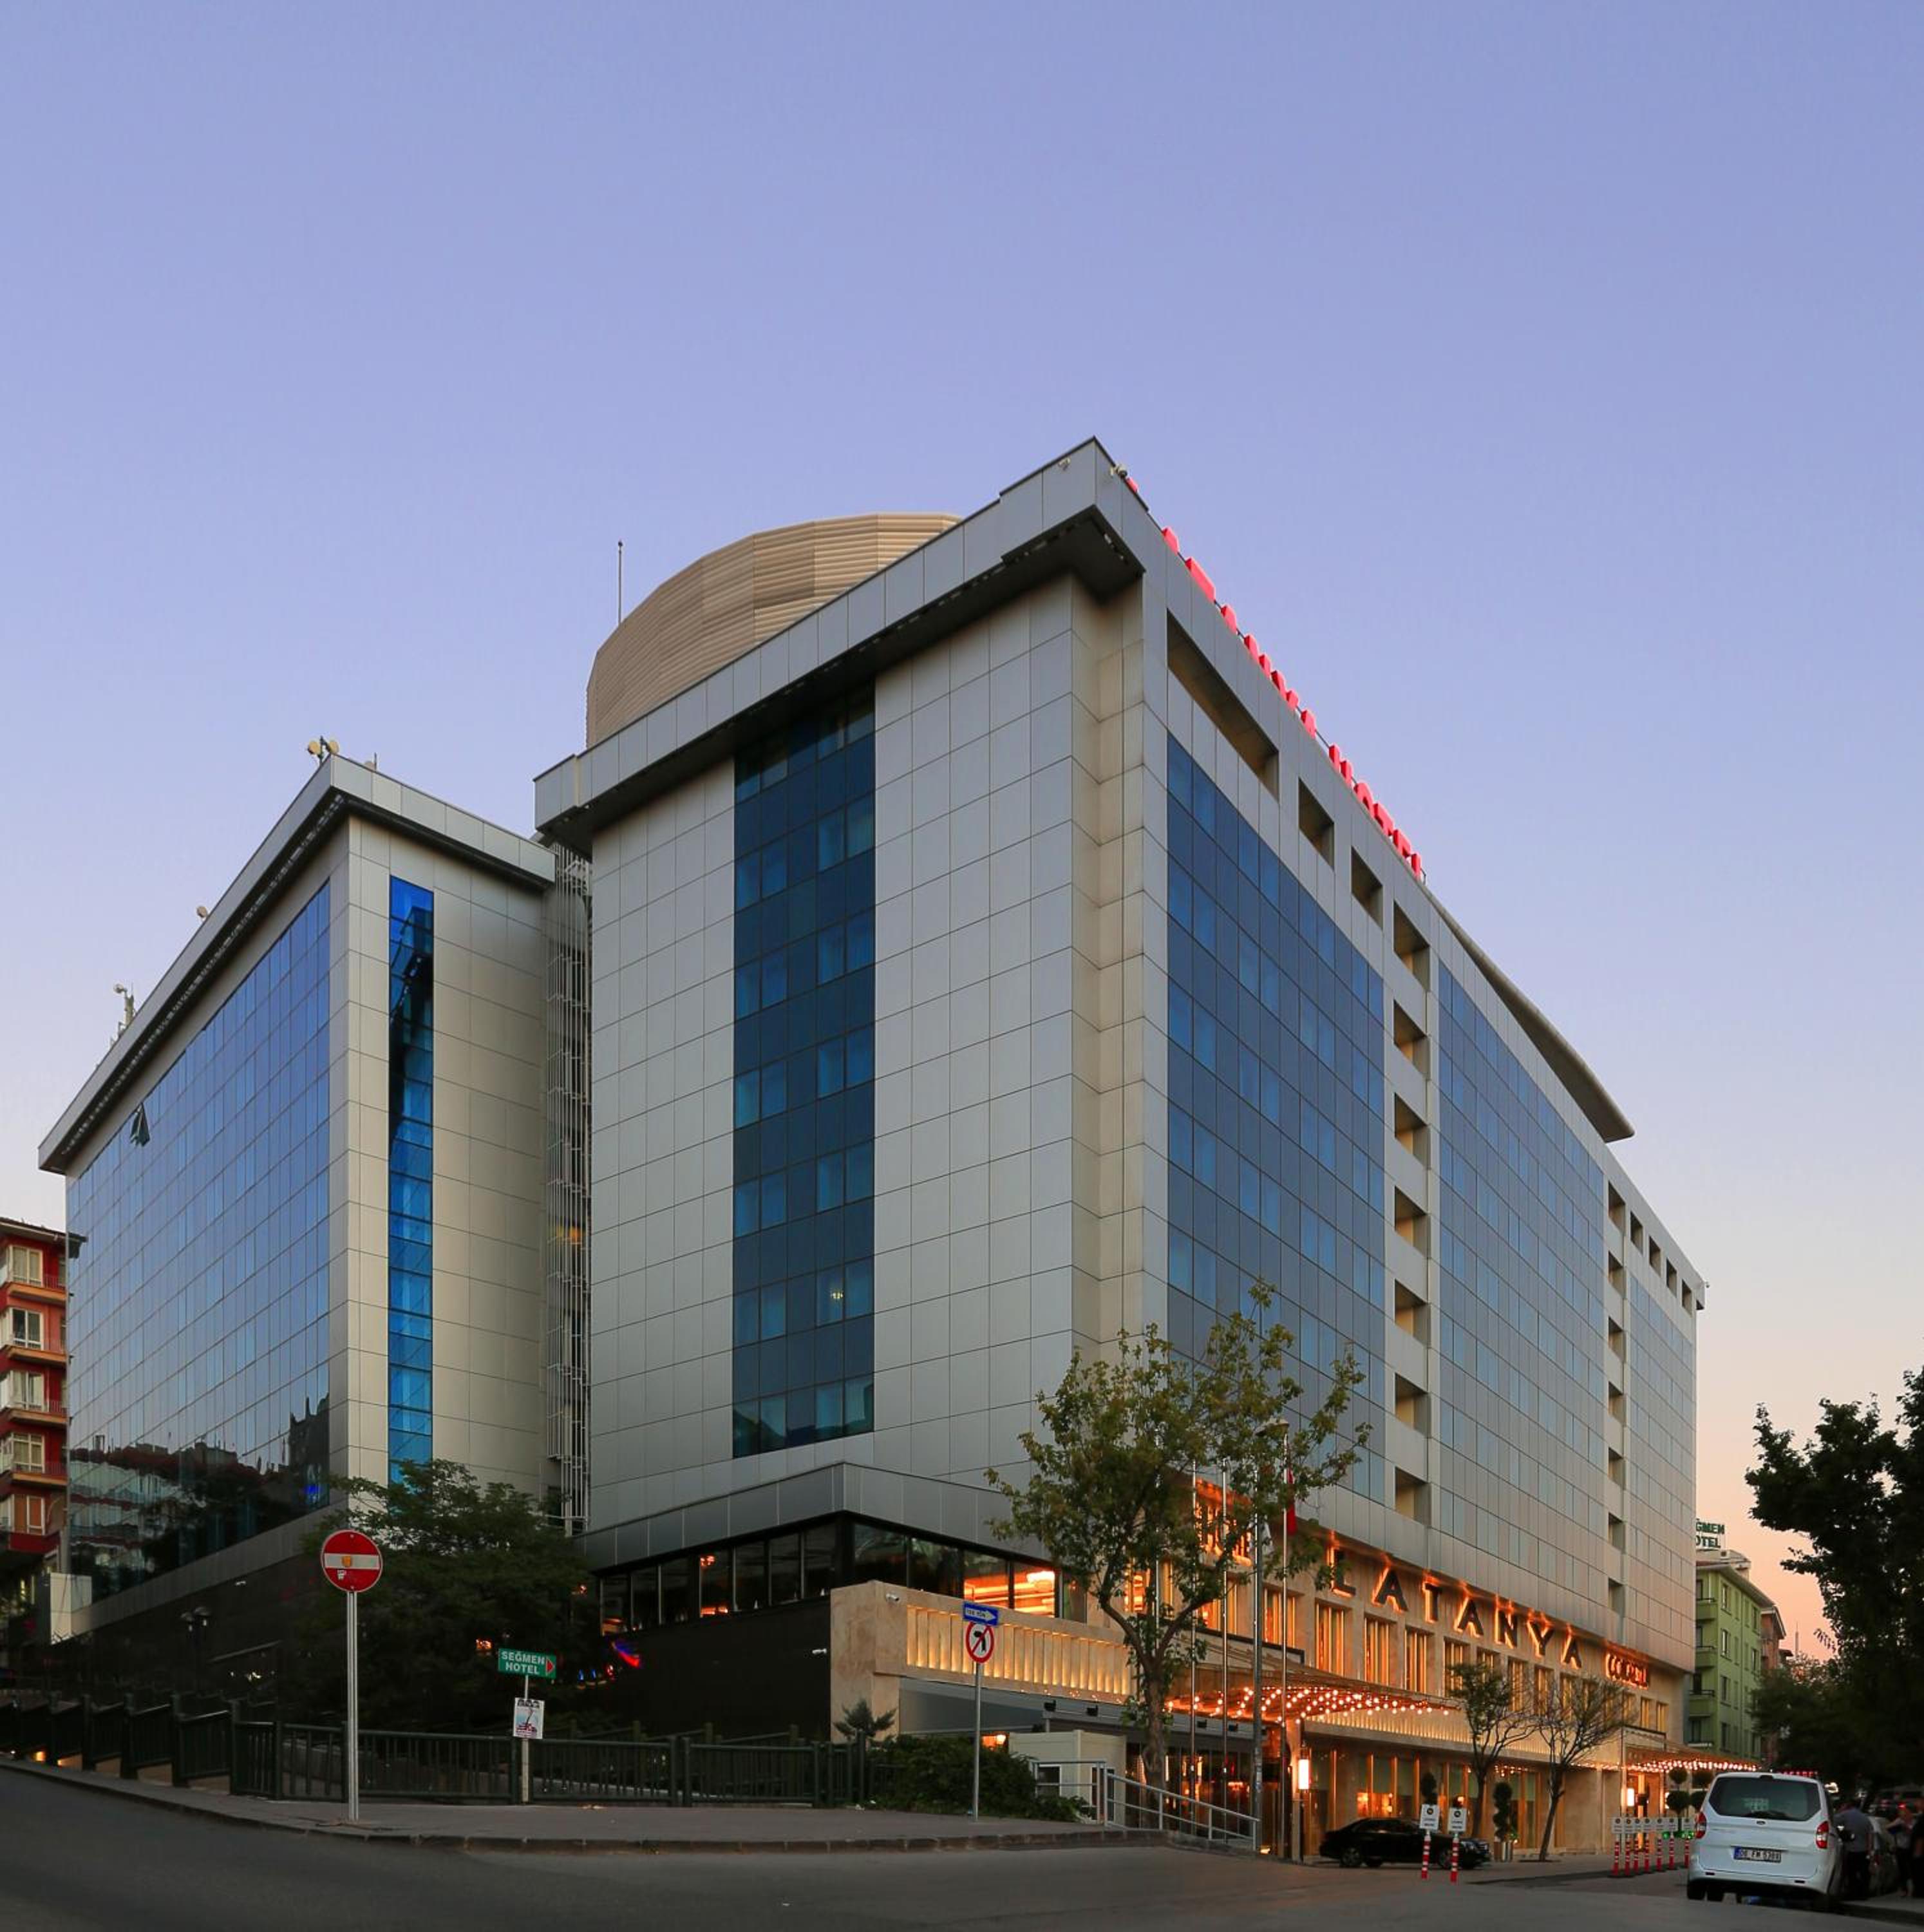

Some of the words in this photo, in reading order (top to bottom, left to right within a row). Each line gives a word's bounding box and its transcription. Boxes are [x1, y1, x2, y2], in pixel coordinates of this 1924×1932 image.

[1328, 1546, 1582, 1669] LATANYA
[502, 1651, 545, 1665] SEĞMEN
[505, 1662, 540, 1674] HOTEL
